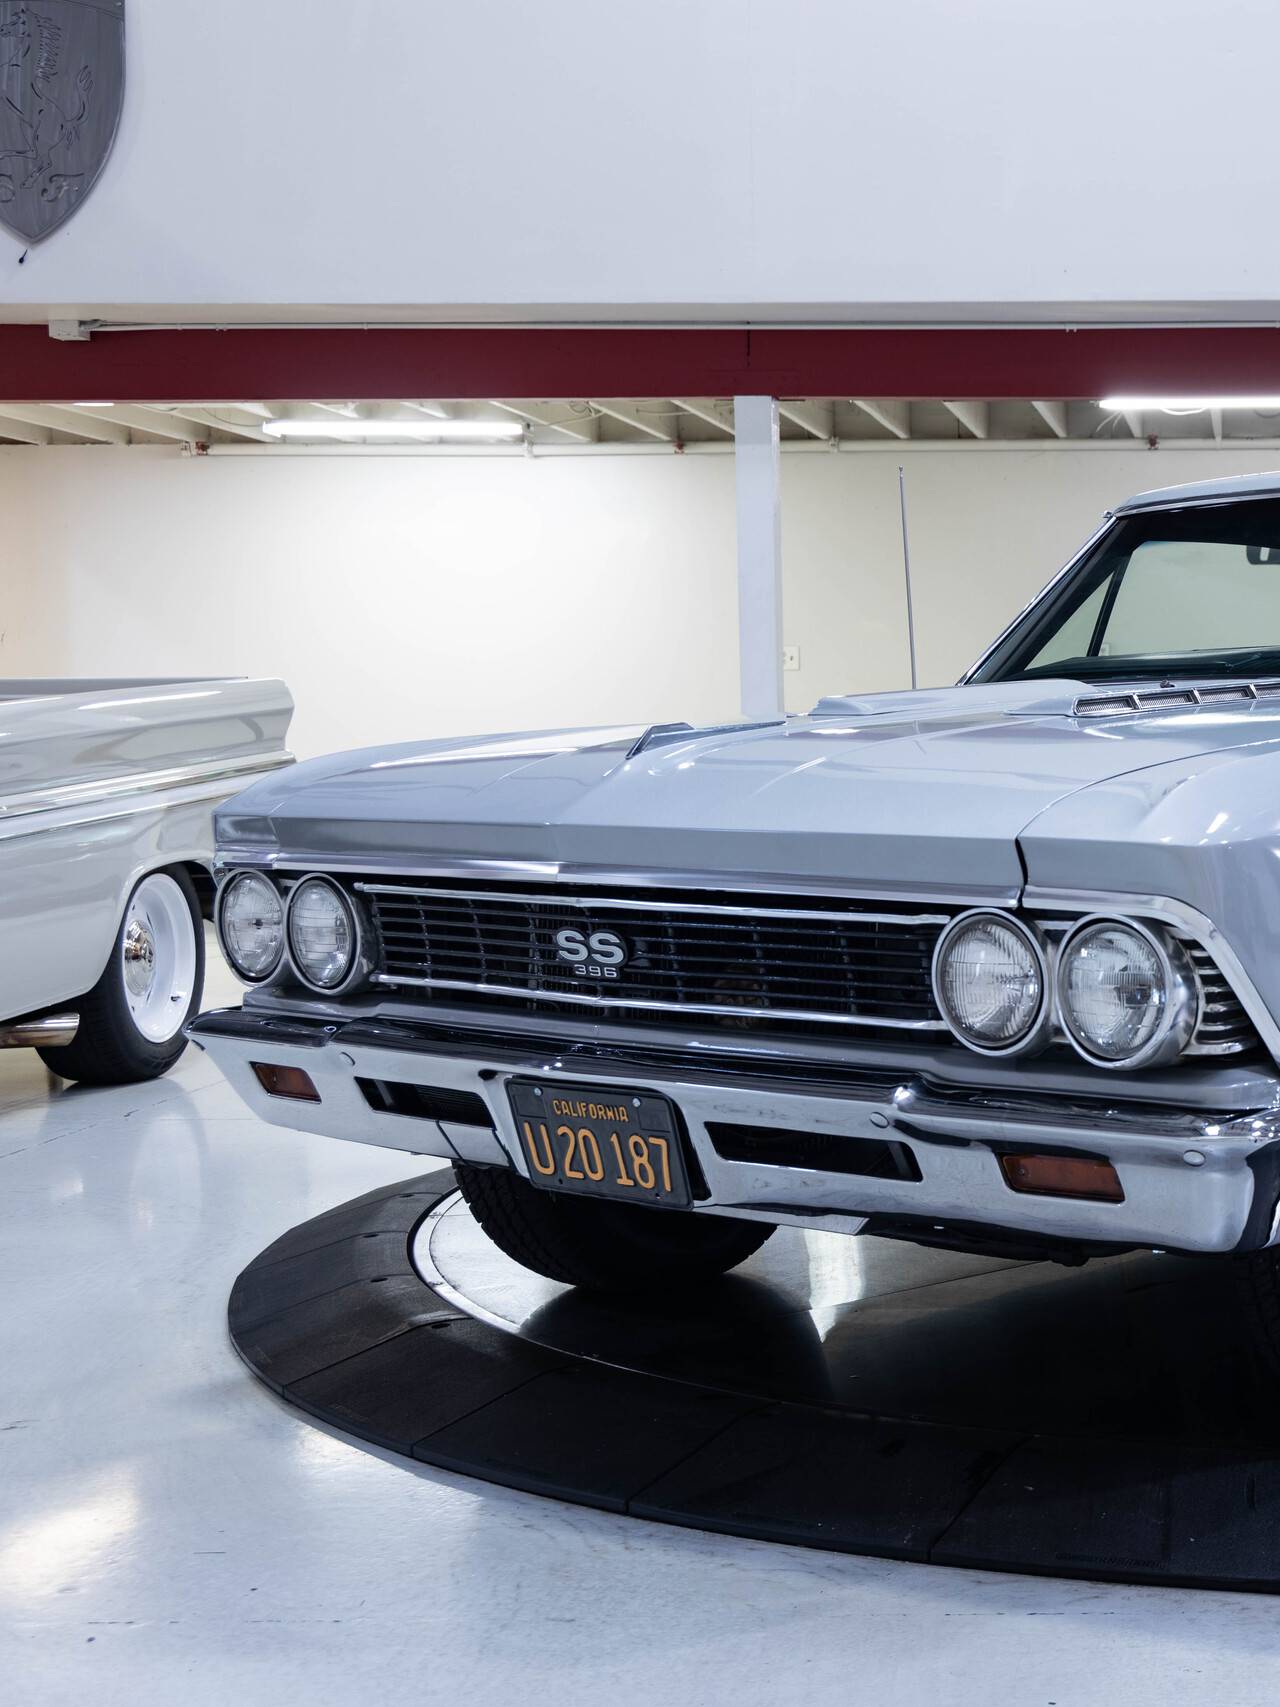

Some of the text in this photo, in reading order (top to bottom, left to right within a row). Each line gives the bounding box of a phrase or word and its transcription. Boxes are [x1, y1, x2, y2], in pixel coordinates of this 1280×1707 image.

[556, 929, 624, 964] SS
[574, 964, 618, 978] 396
[552, 1099, 630, 1123] CALIFORNIA
[523, 1121, 672, 1193] U20 187
